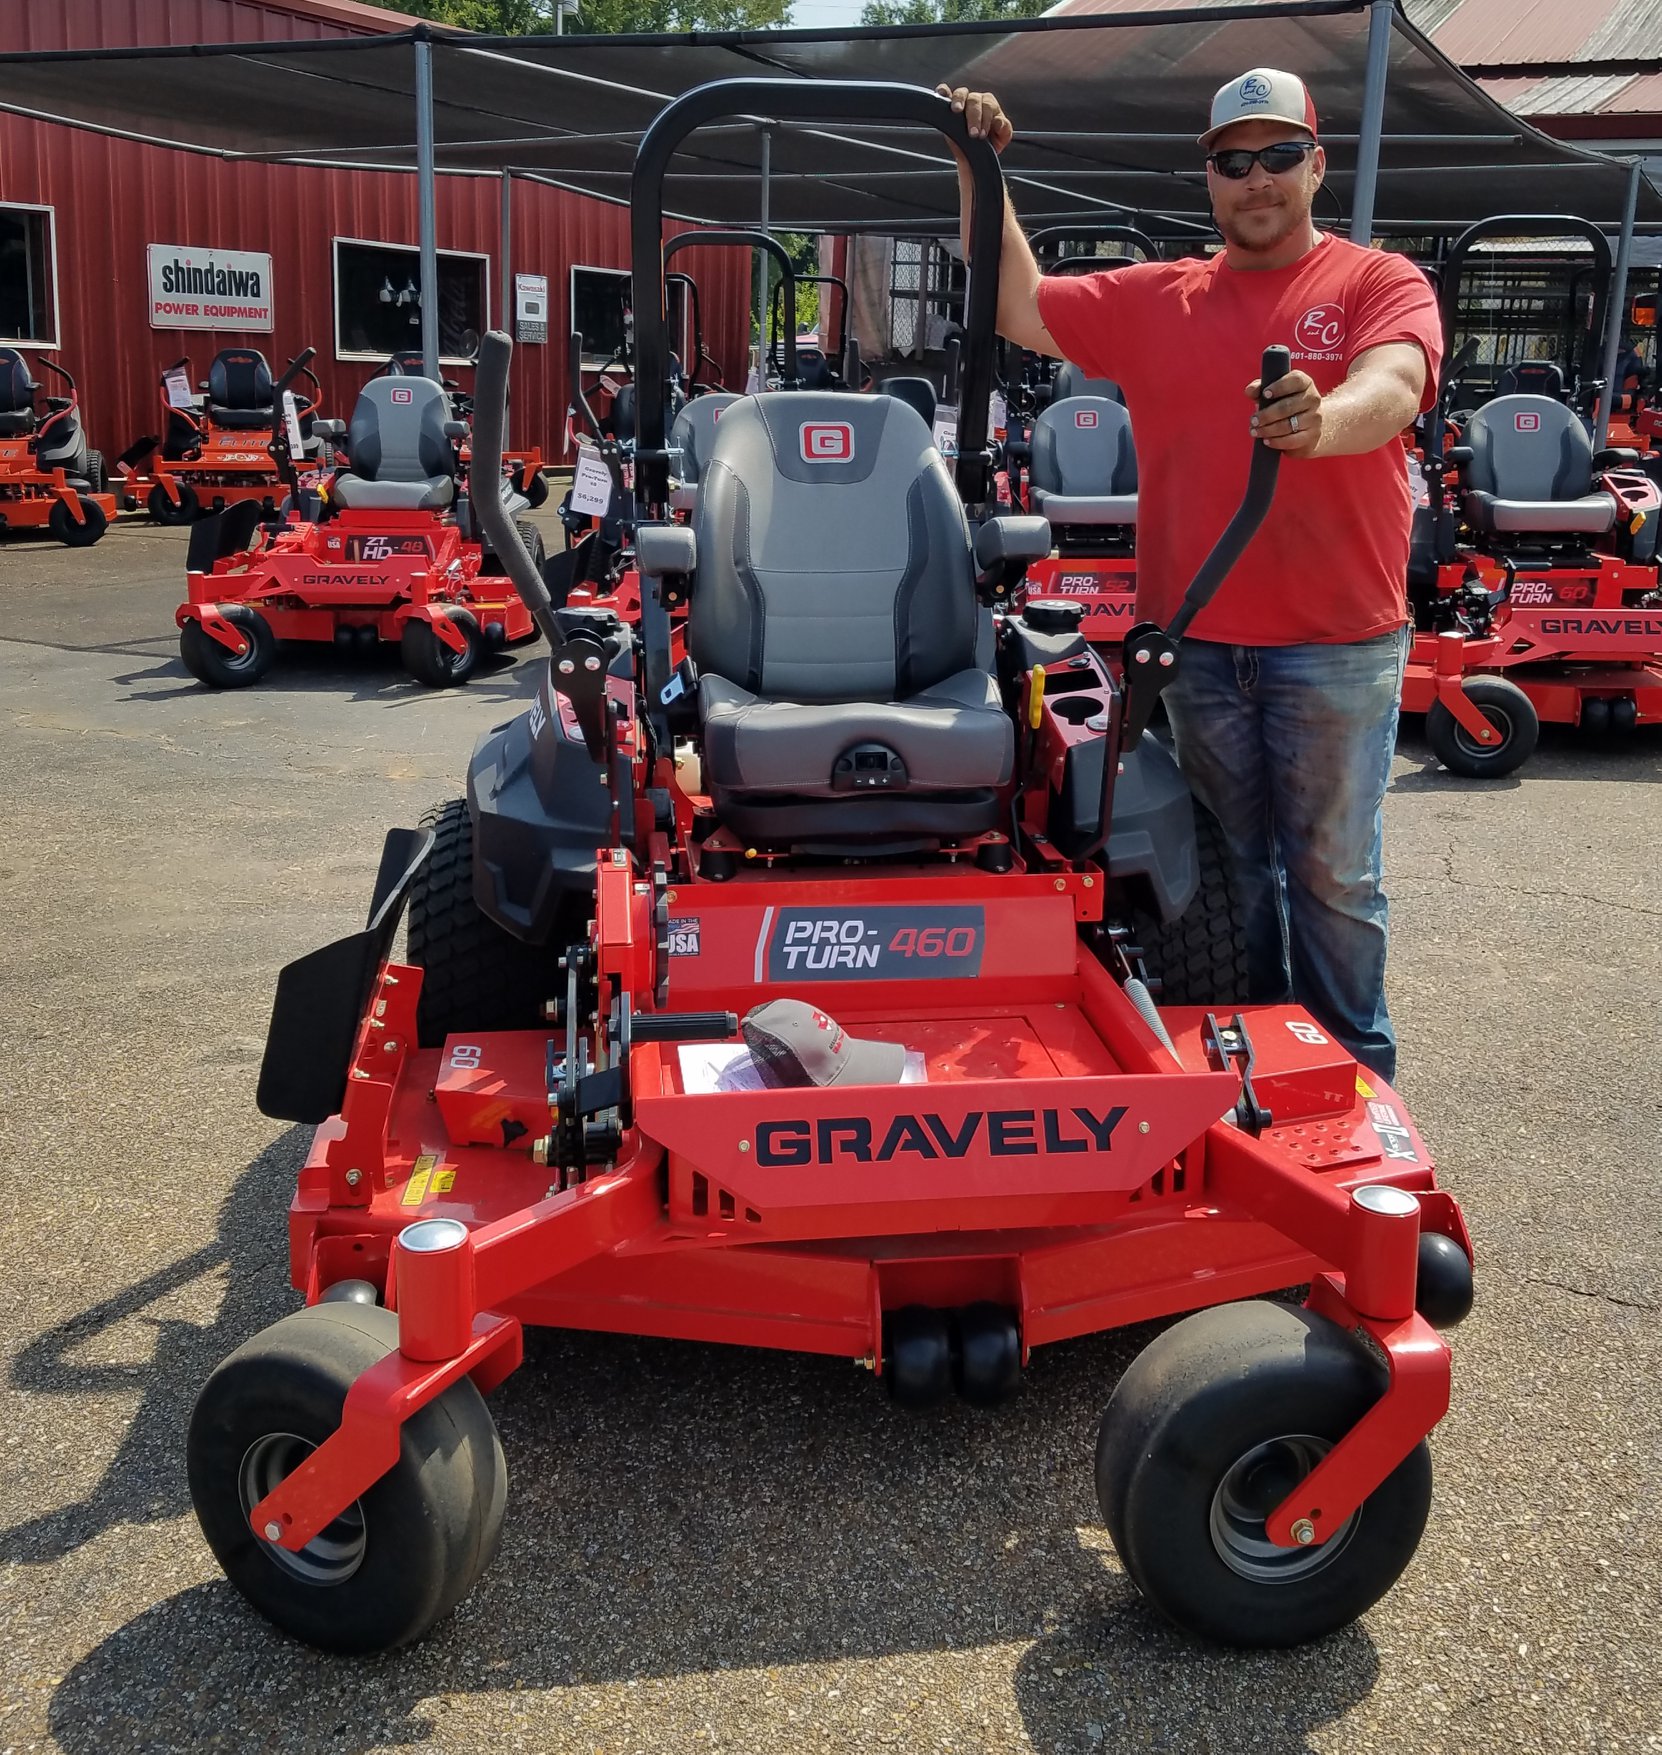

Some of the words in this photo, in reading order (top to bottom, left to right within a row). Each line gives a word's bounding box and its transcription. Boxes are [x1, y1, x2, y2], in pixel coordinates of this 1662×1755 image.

[162, 258, 261, 298] shindaiwa
[154, 302, 200, 316] POWER
[204, 304, 268, 319] EQUIPMENT
[520, 322, 538, 331] SALES
[1304, 311, 1326, 329] R
[519, 331, 545, 340] SERVICE
[1322, 322, 1340, 344] C
[366, 537, 388, 546] ZT
[303, 575, 391, 585] GRAVELY
[1062, 576, 1098, 586] PRO-
[1510, 582, 1552, 593] PRO-
[1510, 594, 1553, 604] TURN
[1559, 586, 1588, 599] 60
[785, 920, 878, 944] PRO-
[888, 928, 976, 958] 460
[782, 944, 880, 970] TURN
[1284, 1021, 1328, 1044] 60
[755, 1106, 1130, 1168] GRAVELY
